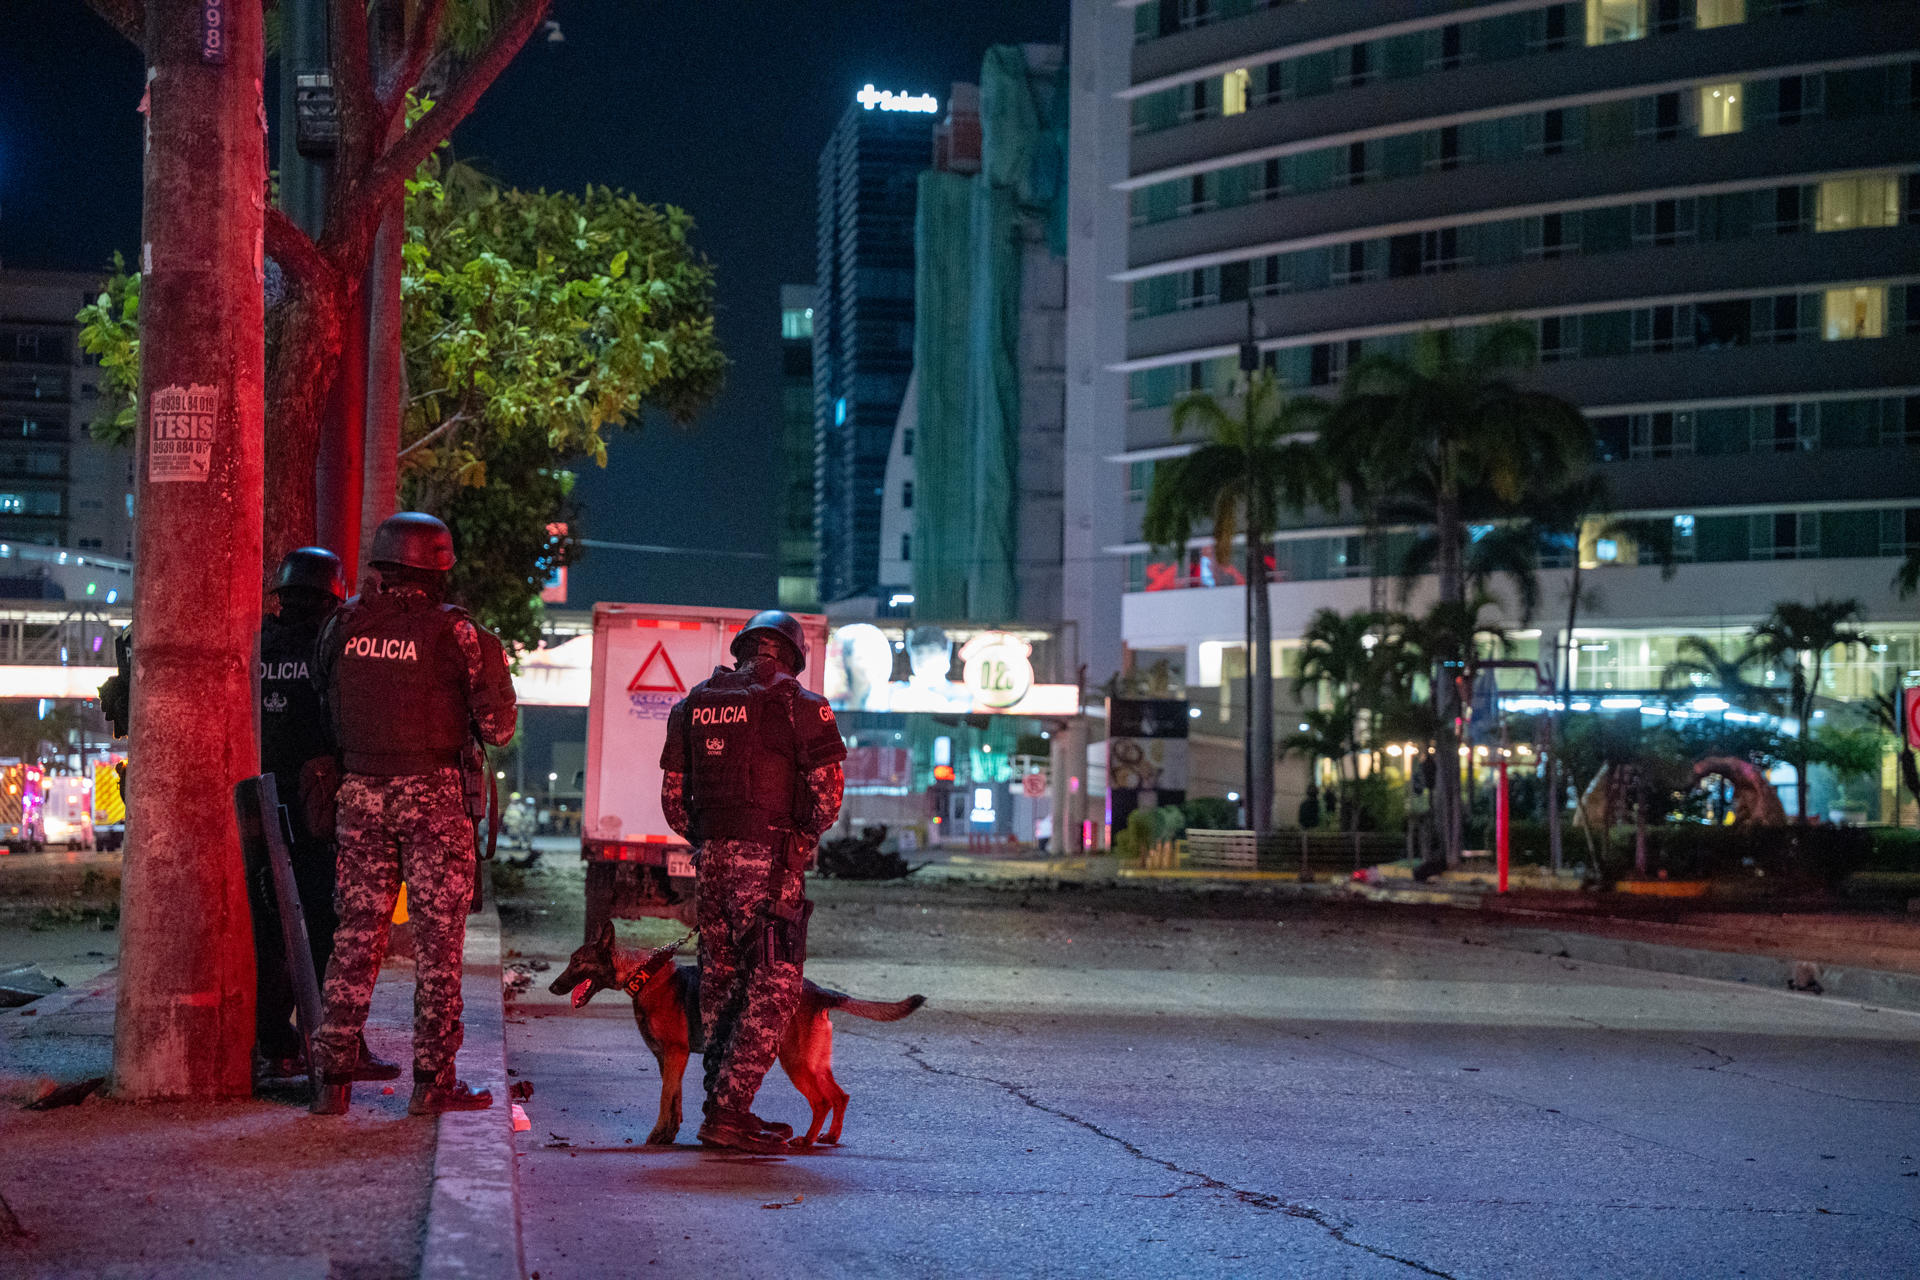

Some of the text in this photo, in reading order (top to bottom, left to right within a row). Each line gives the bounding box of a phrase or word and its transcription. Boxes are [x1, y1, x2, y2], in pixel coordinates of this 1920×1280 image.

[154, 414, 213, 439] TESIS
[344, 636, 418, 661] POLICIA
[260, 661, 310, 679] OLICIA
[692, 705, 748, 726] POLICIA
[670, 861, 695, 873] GTN
